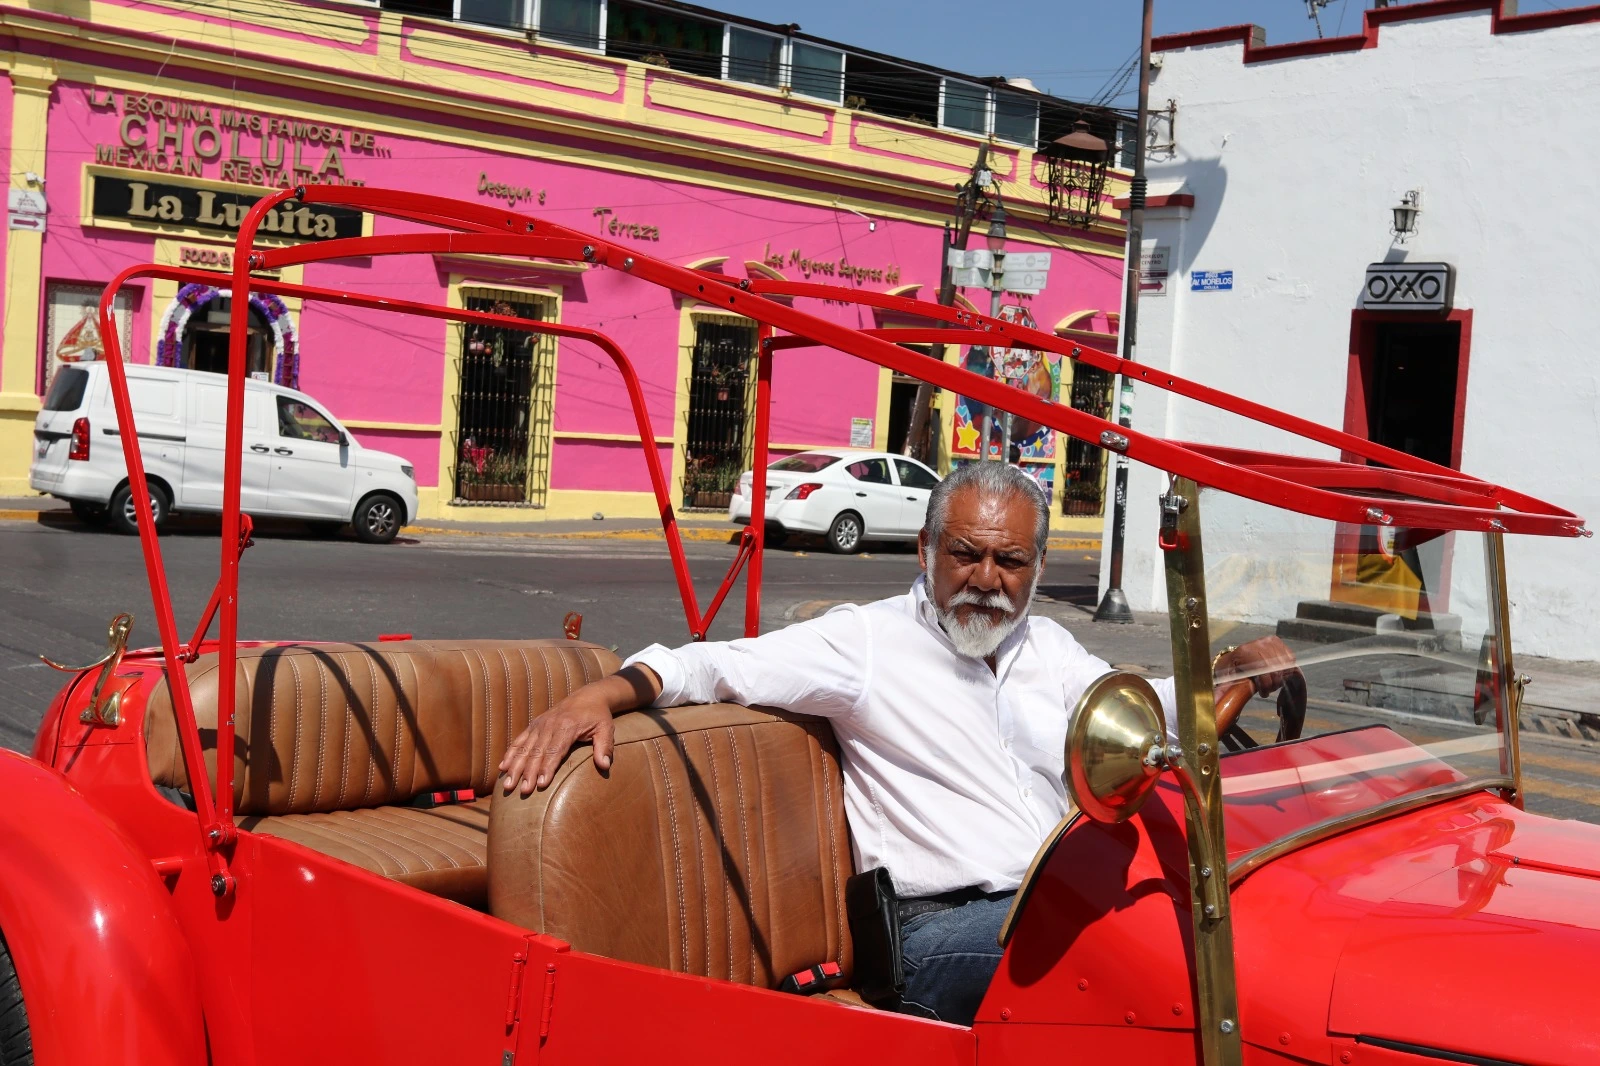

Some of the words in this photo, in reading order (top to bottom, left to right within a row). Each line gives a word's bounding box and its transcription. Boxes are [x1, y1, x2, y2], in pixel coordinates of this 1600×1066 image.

[89, 88, 117, 109] LA
[124, 94, 214, 123] ESQUINA
[220, 109, 262, 131] MAS
[268, 118, 345, 145] FAMOSA
[96, 143, 203, 174] MEXICAN
[120, 114, 345, 177] CHOLULA
[478, 172, 532, 203] Desayun
[127, 182, 184, 221] La
[196, 191, 338, 239] Lunita
[180, 246, 219, 265] FOOD
[219, 252, 231, 268] &
[764, 243, 784, 264] Las
[1202, 277, 1233, 286] MORELOS
[1368, 274, 1441, 301] OXXO
